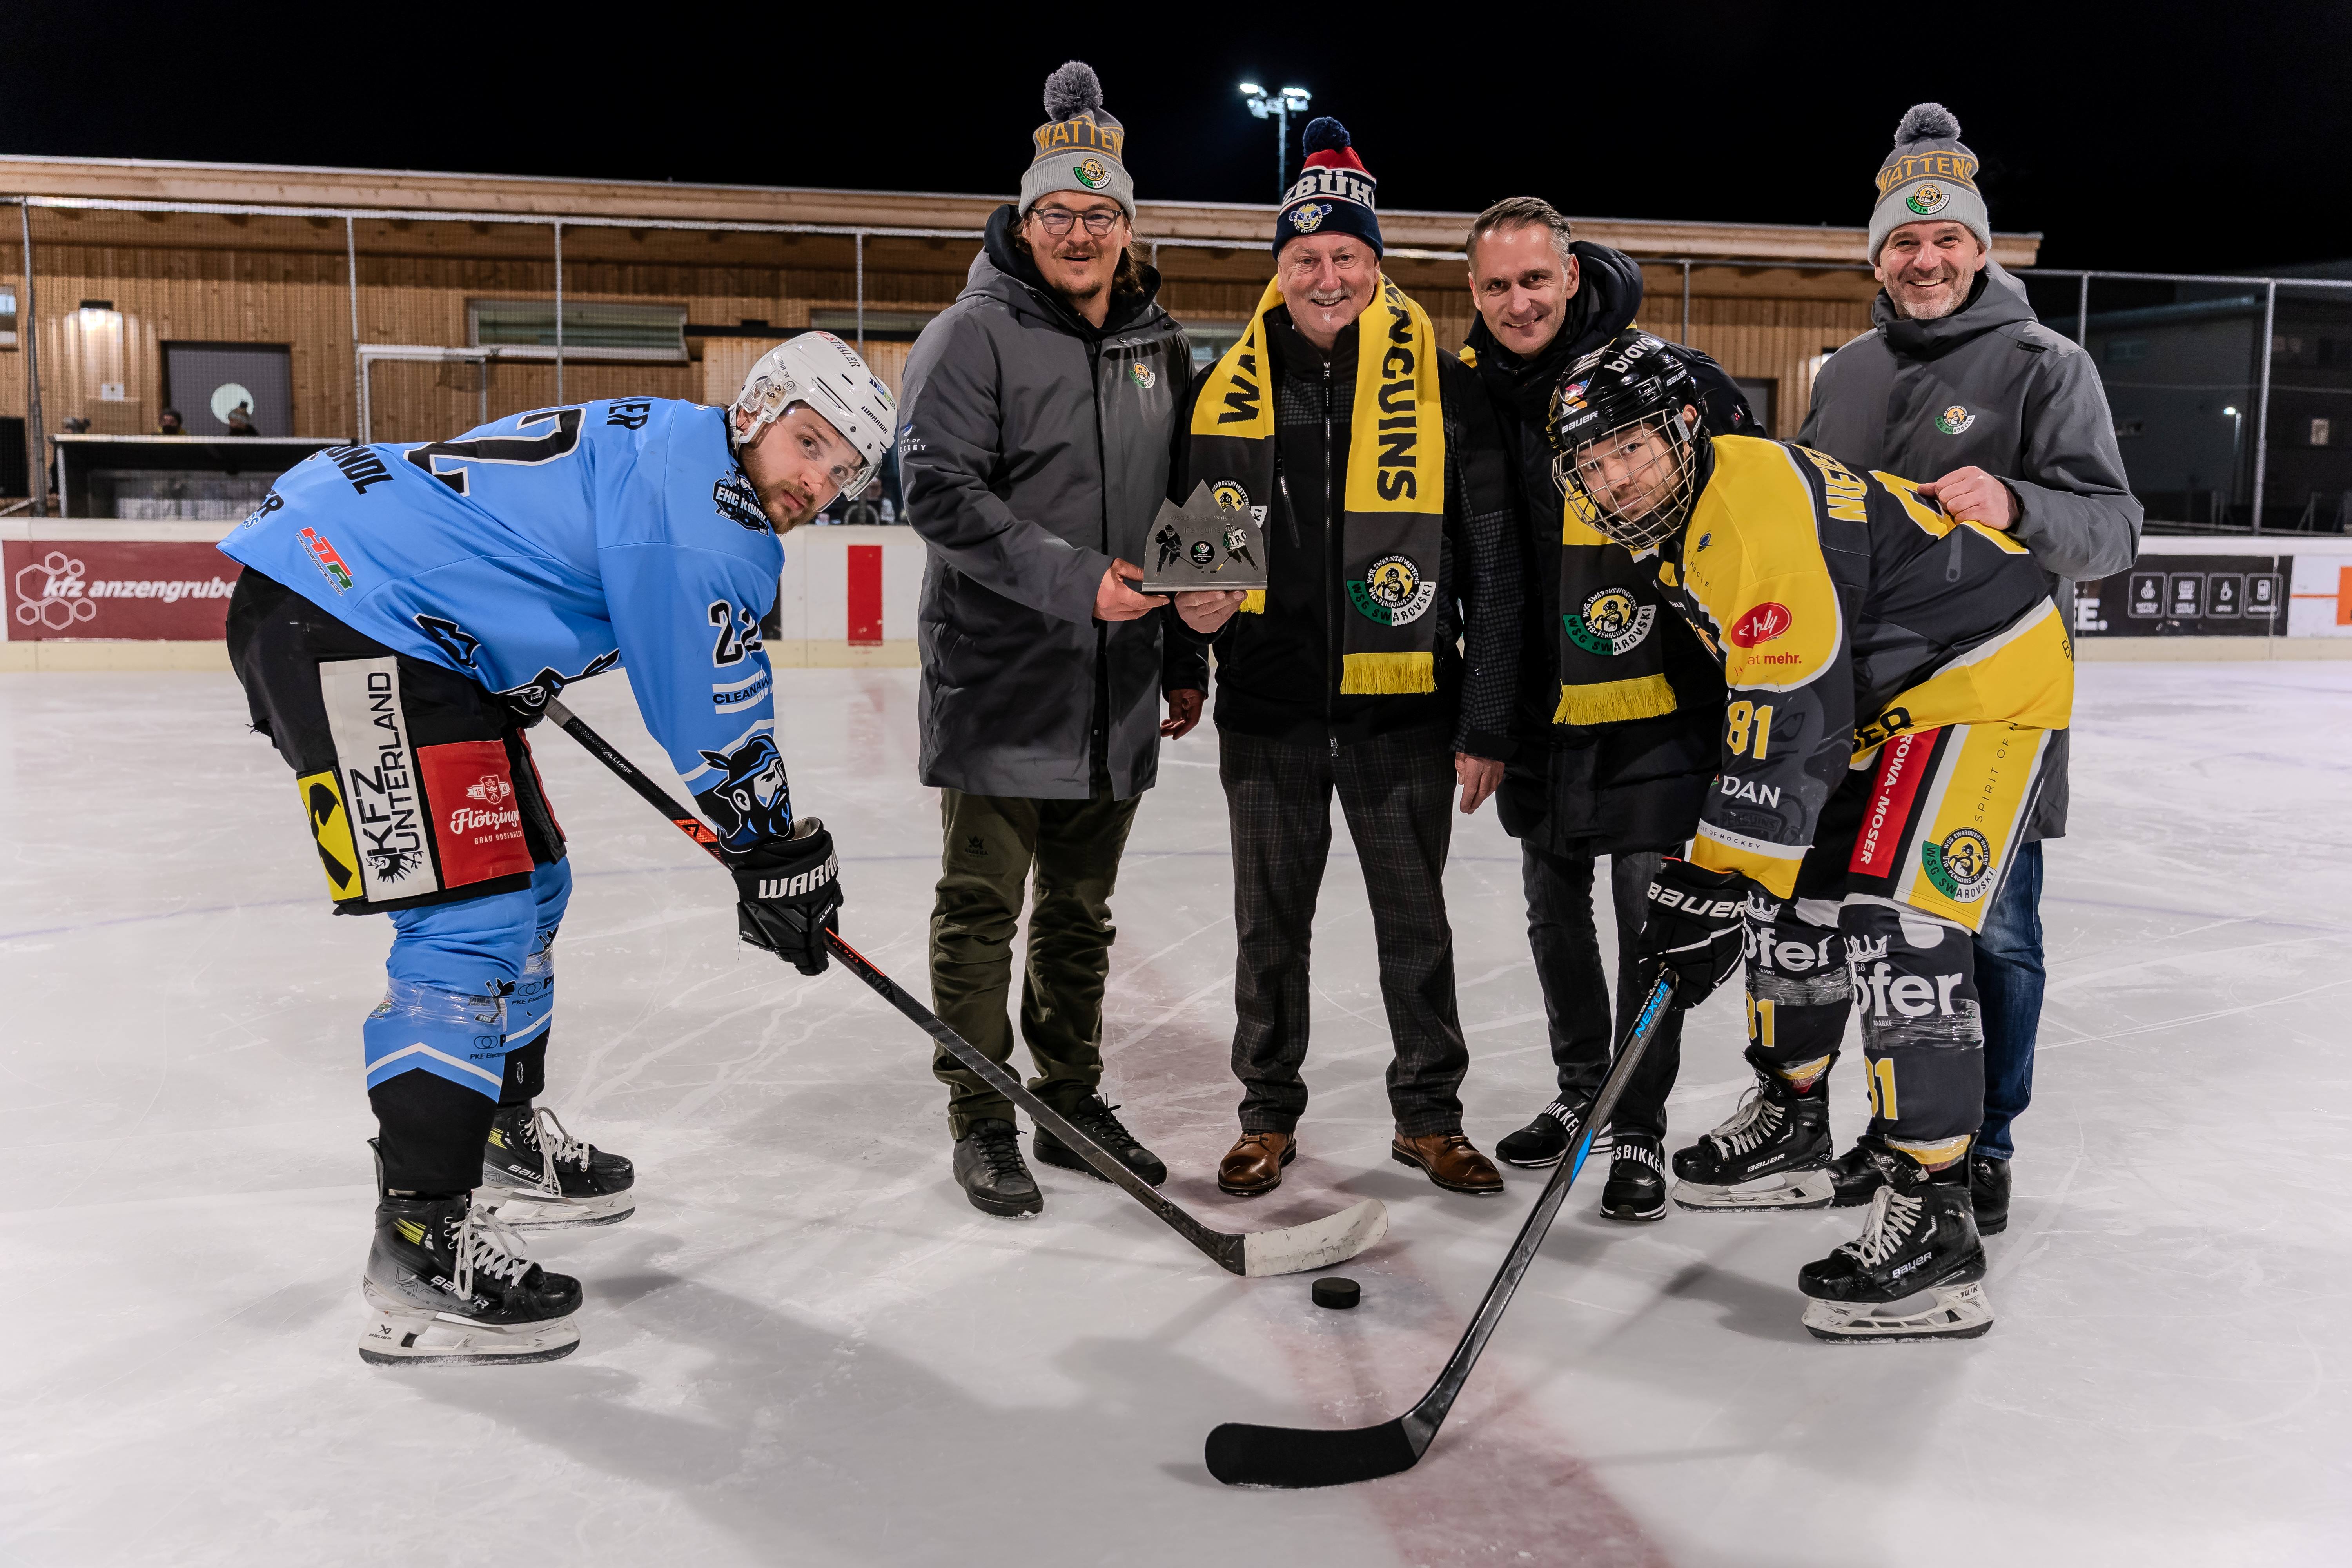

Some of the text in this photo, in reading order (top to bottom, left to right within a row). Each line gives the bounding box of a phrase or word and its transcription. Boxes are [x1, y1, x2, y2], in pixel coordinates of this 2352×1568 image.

[1918, 196, 1947, 213] SWAROVSKI
[1376, 274, 1417, 501] ENGUINS
[1666, 368, 1688, 387] BAUER
[861, 405, 889, 434] WARRIOR
[1562, 411, 1598, 434] BAUER
[1944, 416, 1973, 433] SWAROVSKI
[716, 486, 740, 506] EHC
[296, 533, 344, 596] www.hockeytown-shop.com
[1367, 568, 1376, 584] WSG
[1404, 559, 1420, 584] WATTENS
[42, 575, 85, 598] kfz
[1352, 583, 1432, 622] WSG SWAROVSKI
[1582, 602, 1592, 618] WSG
[708, 599, 764, 668] 22
[1567, 608, 1651, 652] WSG SWAROVSKI
[1764, 652, 1802, 664] mehr.
[1726, 700, 1773, 760] 81
[367, 671, 421, 854] UNTERLAND
[1974, 737, 2010, 824] SPIRIT OF
[349, 765, 396, 857] KFZ
[1860, 734, 1915, 865] ROWA-MOSER
[474, 834, 493, 845] BRÄU
[1720, 834, 1760, 849] HOCKEY
[1943, 830, 1989, 866] WSG SWAROVSKI WATTENS
[758, 847, 839, 899] WARRI
[1926, 847, 1994, 898] WSG SWAROVSKI
[1948, 869, 1972, 884] PENGUINS
[819, 903, 834, 923] ALPHA
[1647, 882, 1748, 919] BAUER
[833, 941, 859, 964] ALPHA
[1634, 981, 1668, 1038] NEXUS
[1747, 1152, 1785, 1173] BAUER
[1891, 1251, 1932, 1279] BAUER
[431, 1275, 490, 1309] BAR
[368, 1333, 392, 1341] BAUER
